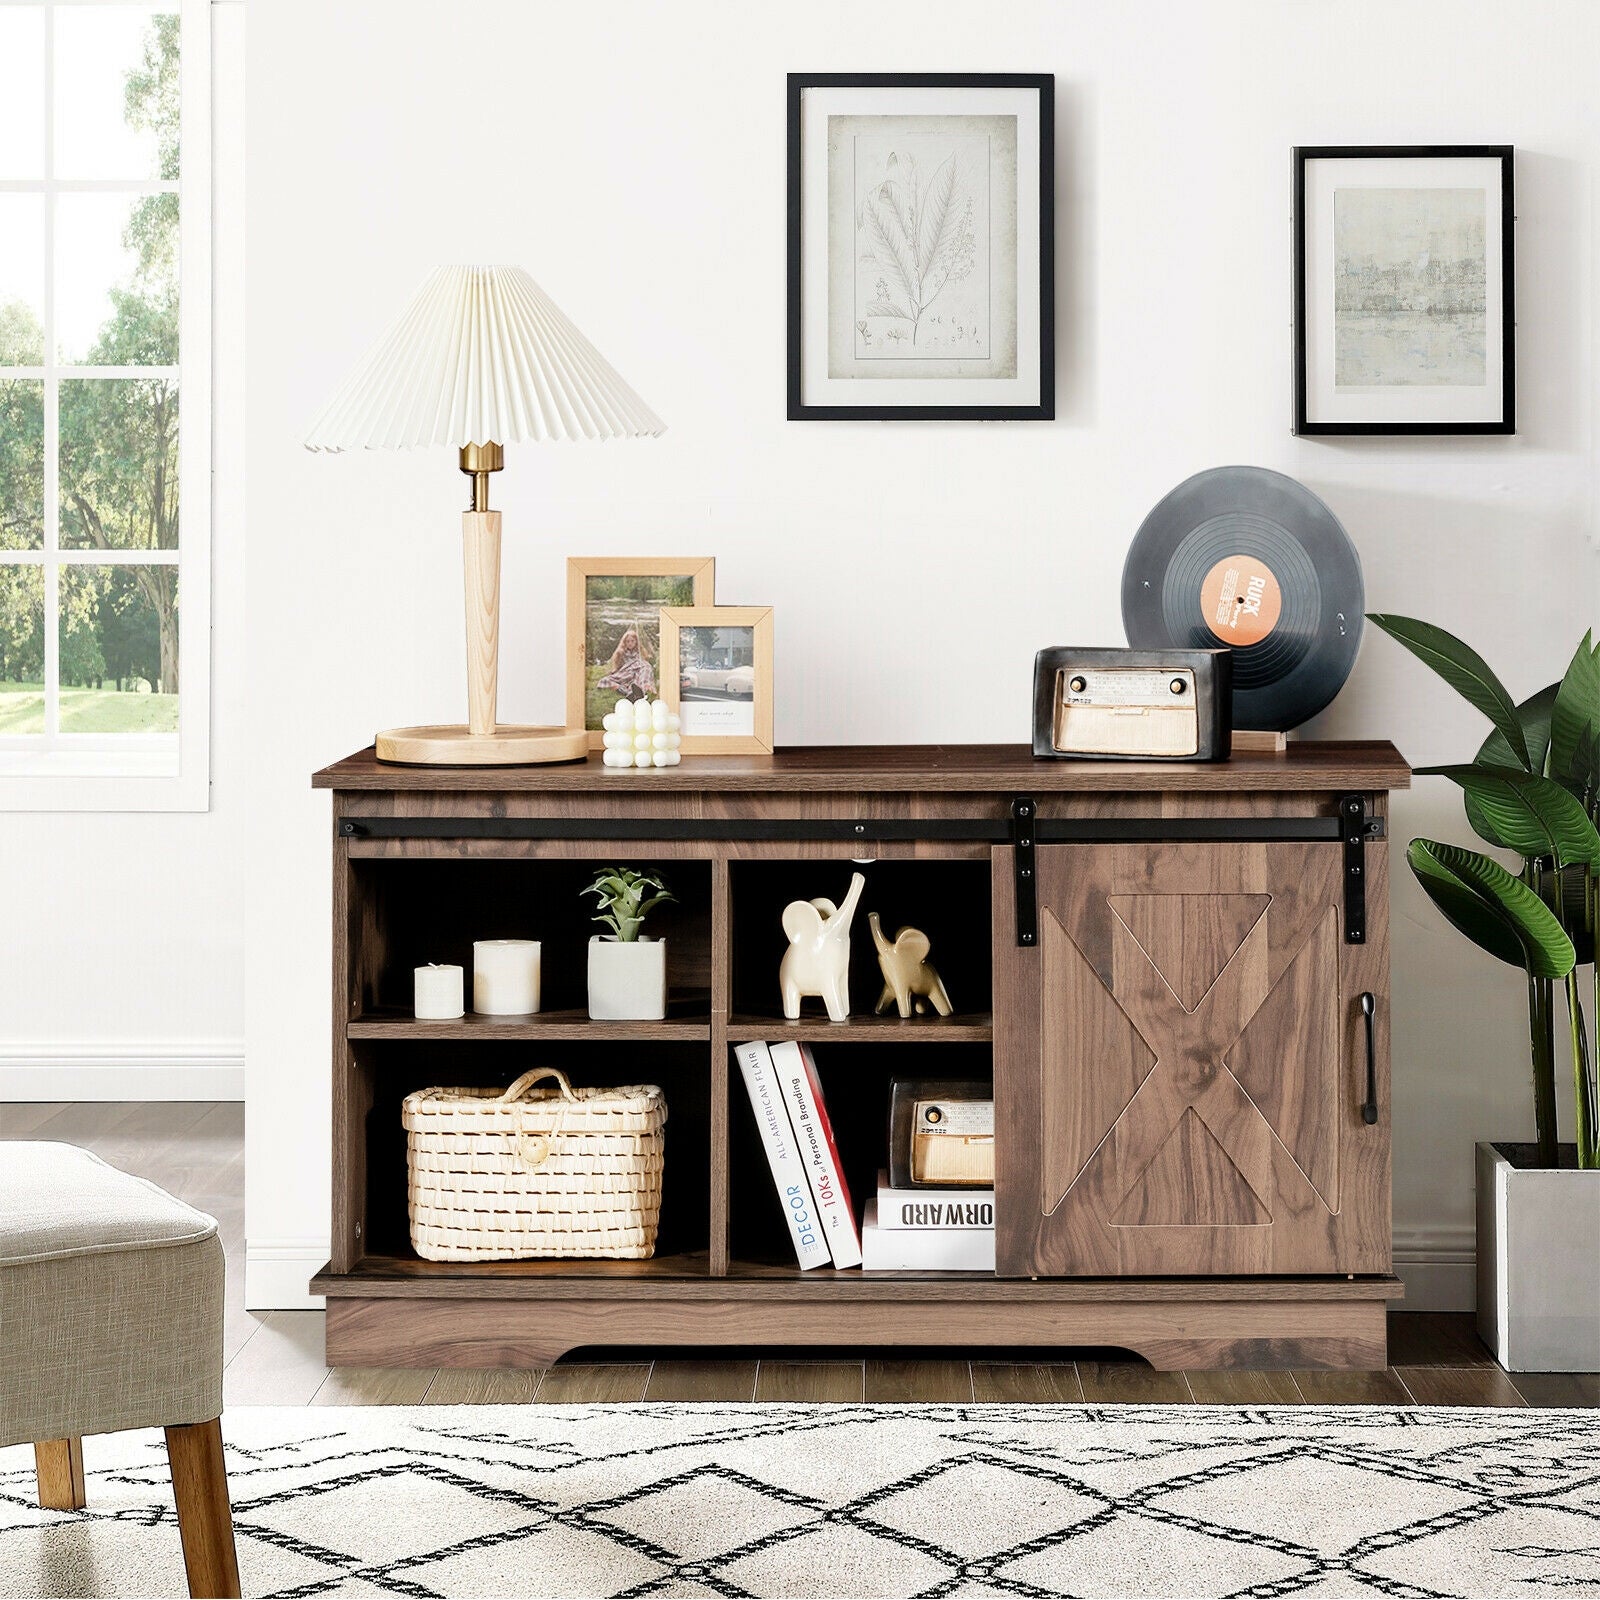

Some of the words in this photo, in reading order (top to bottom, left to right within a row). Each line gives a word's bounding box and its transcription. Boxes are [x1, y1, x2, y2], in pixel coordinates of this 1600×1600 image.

[748, 1052, 763, 1082] FLAIR
[791, 1078, 809, 1121] Branding
[760, 1085, 787, 1160] ALL-AMERICAN
[802, 1123, 822, 1166] Personal
[786, 1185, 815, 1245] DECOR
[901, 1203, 993, 1225] ORWARD
